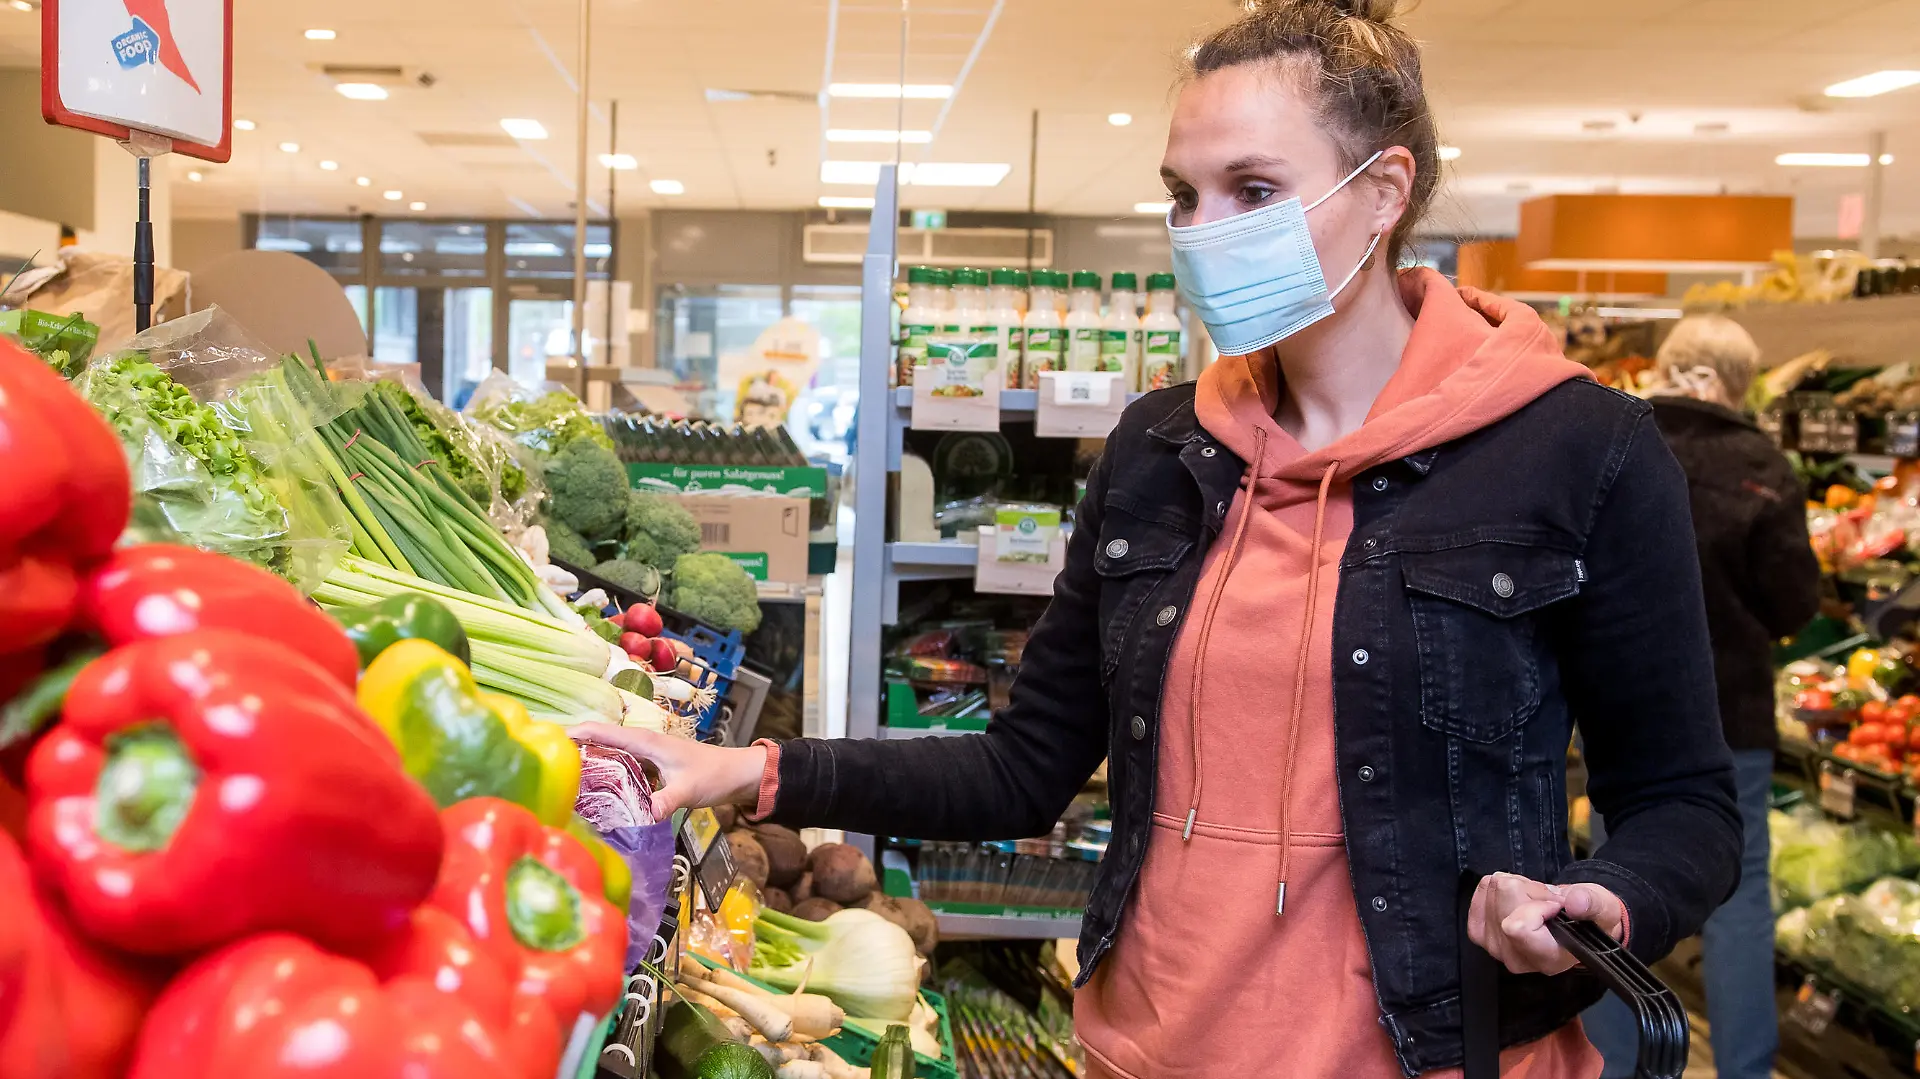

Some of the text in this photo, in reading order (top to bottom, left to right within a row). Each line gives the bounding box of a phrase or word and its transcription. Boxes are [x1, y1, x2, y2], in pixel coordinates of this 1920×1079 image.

[116, 31, 148, 50] ORGANIC
[119, 40, 152, 62] FOOD
[37, 318, 69, 332] Bio-Kräutr
